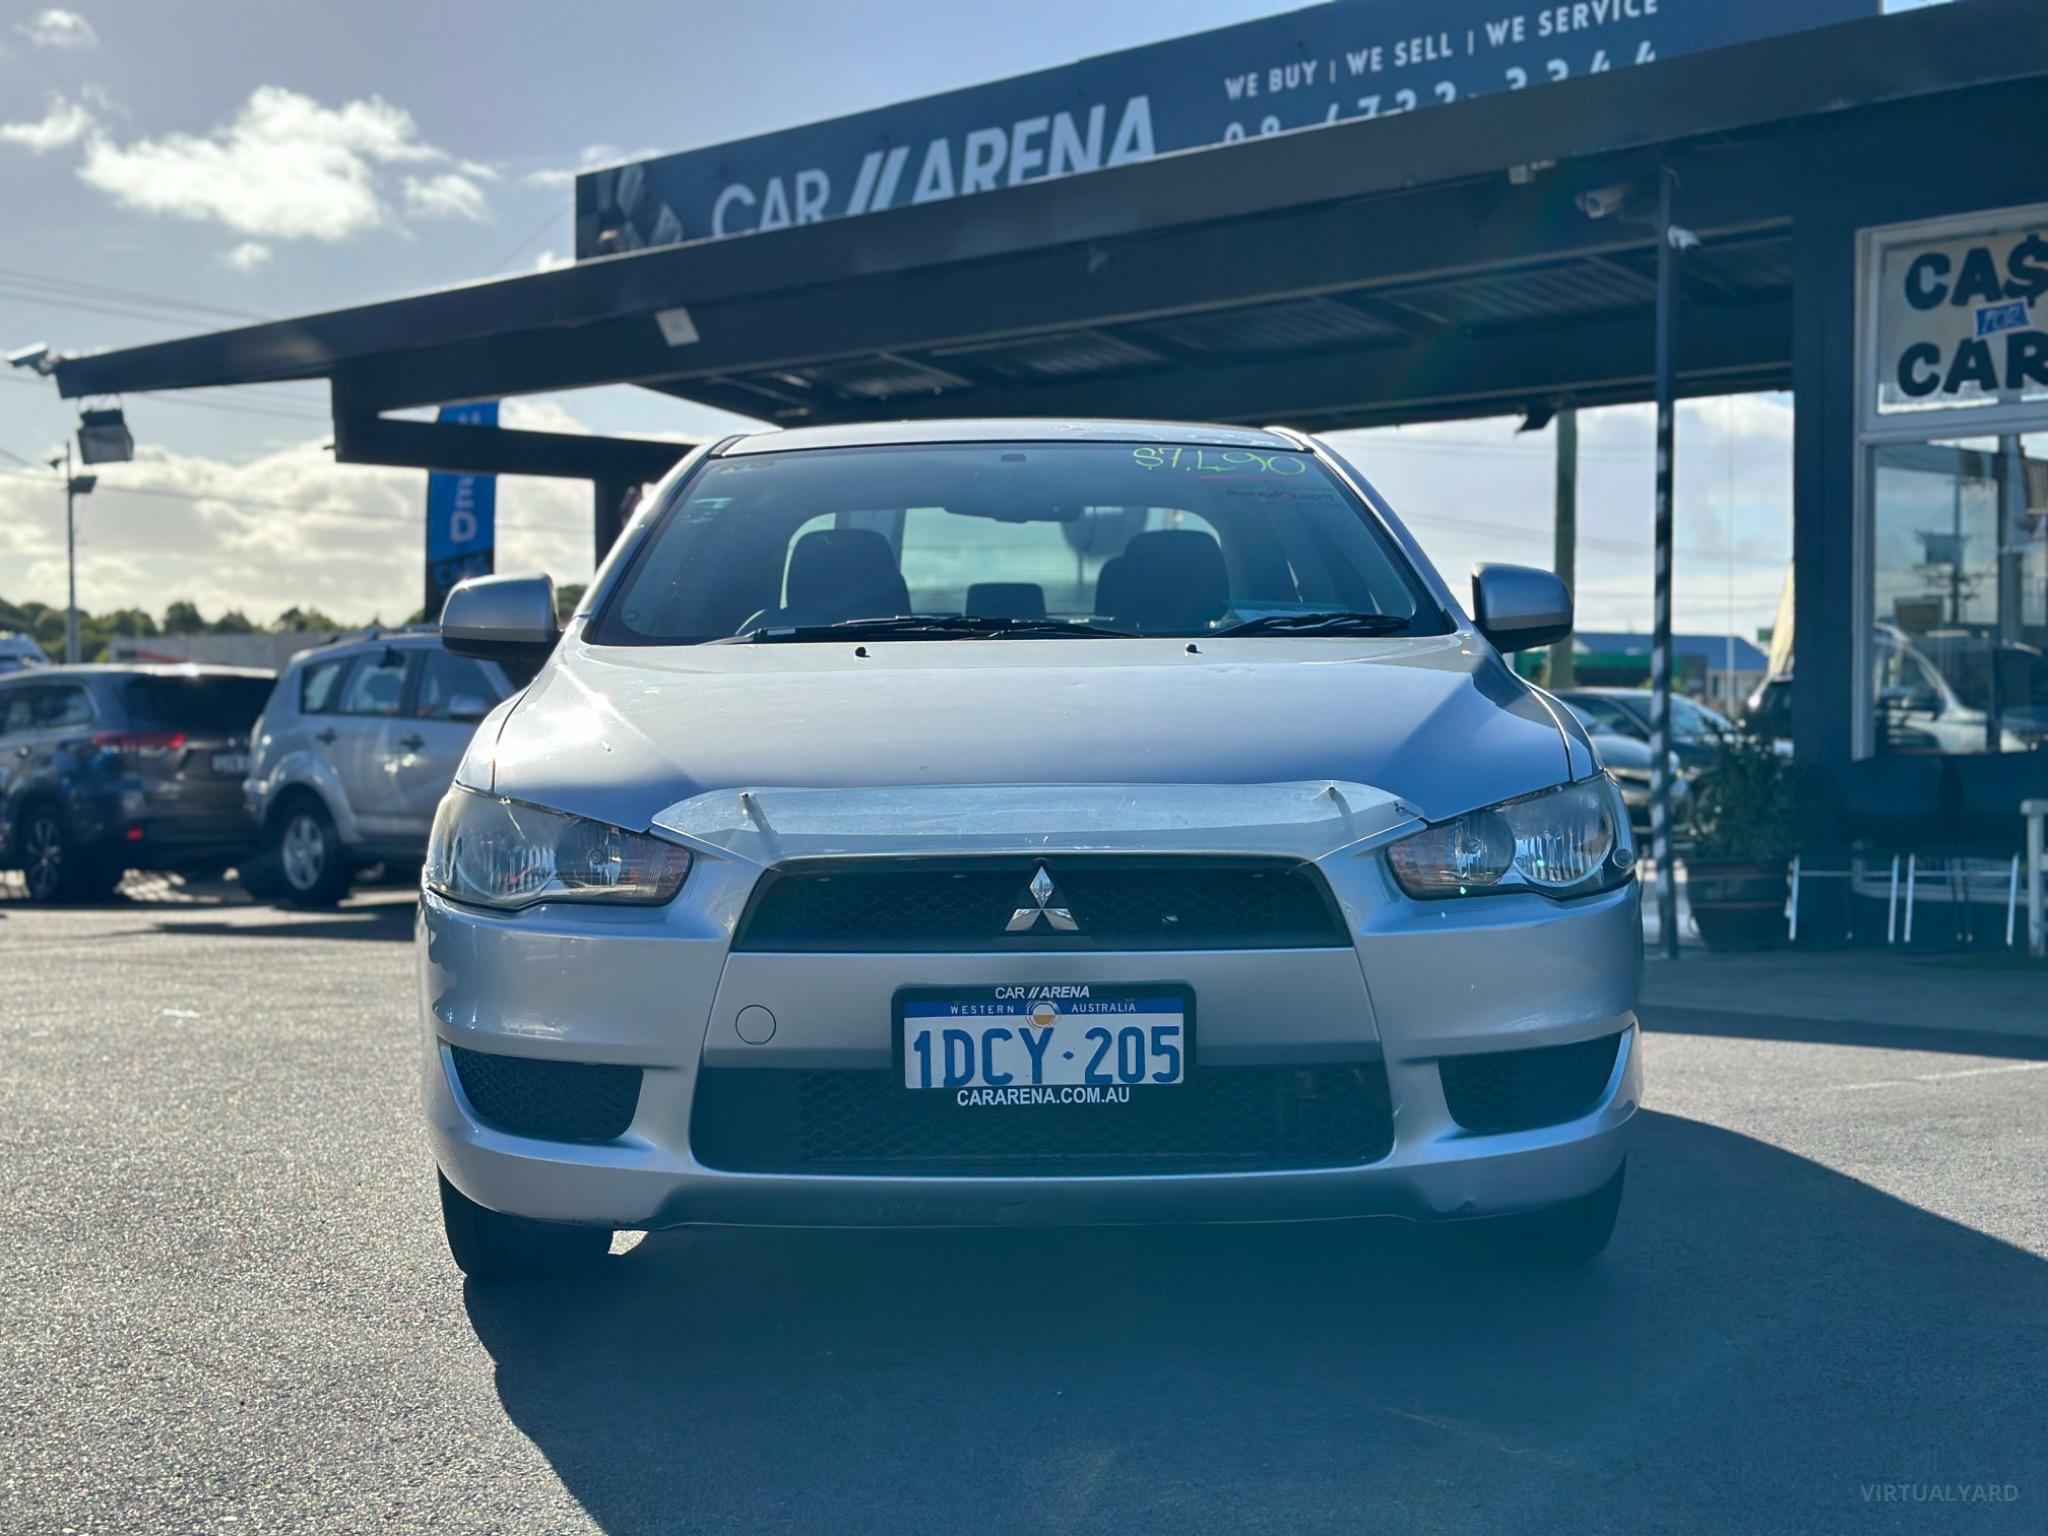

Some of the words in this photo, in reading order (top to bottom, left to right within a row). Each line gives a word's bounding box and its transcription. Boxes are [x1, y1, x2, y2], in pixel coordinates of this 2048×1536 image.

[1224, 73, 1258, 100] WE
[1269, 60, 1317, 92] BUY
[1346, 46, 1383, 75] WE
[1394, 32, 1453, 67] SELL
[1485, 15, 1525, 47] WE
[711, 168, 830, 238] CAR
[911, 95, 1156, 205] ARENA
[1897, 330, 2048, 398] CAR
[950, 1004, 1015, 1015] WESTERN
[1071, 1002, 1136, 1013] AUSTRALIA
[995, 987, 1025, 999] CAR
[1039, 985, 1090, 999] ARENA
[957, 1087, 1130, 1107] CARARENA.COM.AU
